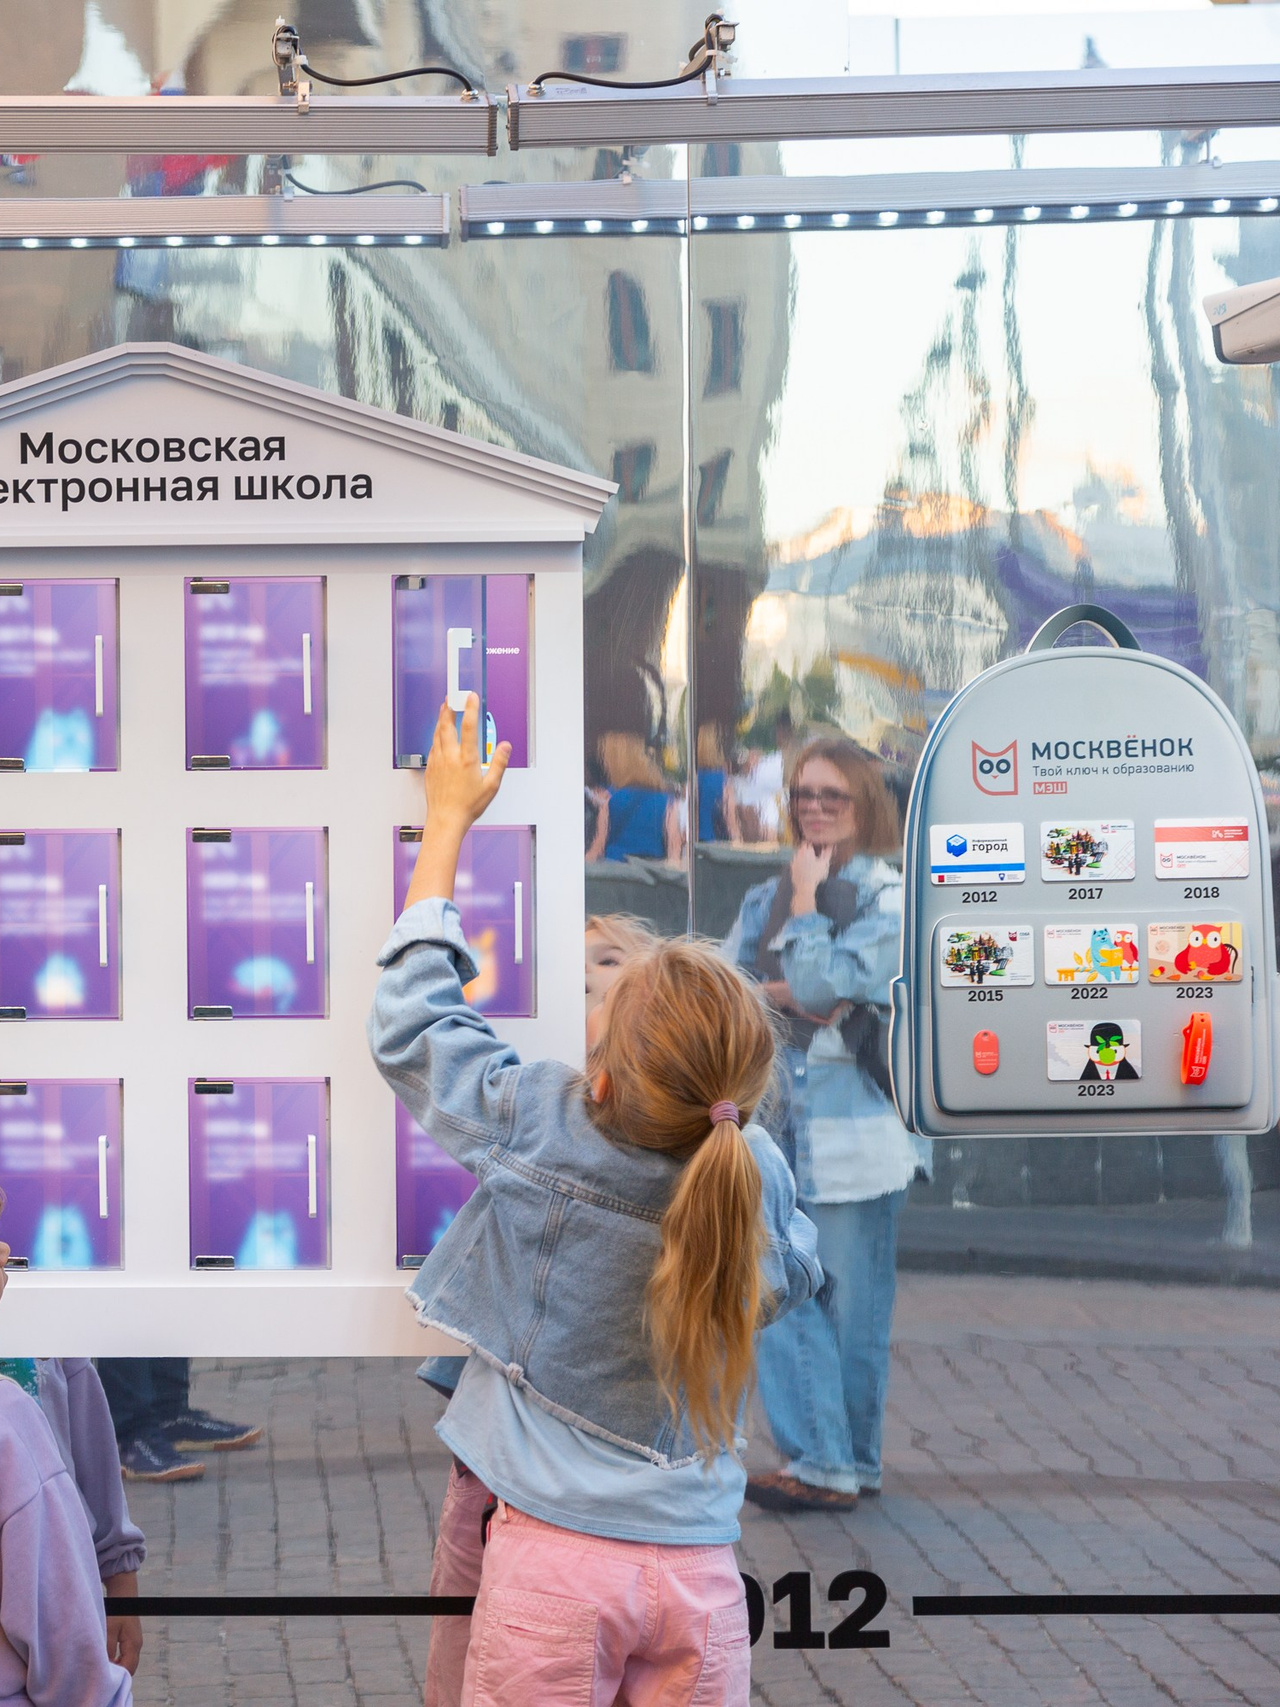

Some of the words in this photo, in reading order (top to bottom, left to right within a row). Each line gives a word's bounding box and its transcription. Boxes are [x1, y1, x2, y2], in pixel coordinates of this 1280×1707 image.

[19, 432, 286, 465] Московская
[234, 473, 373, 500] школа
[1032, 734, 1194, 760] МОСКВЁНОК
[1033, 765, 1062, 777] Твой
[1066, 766, 1098, 776] ключ
[1102, 766, 1109, 775] к
[1112, 763, 1194, 776] образованию
[1035, 782, 1066, 794] МЭШ
[972, 843, 1008, 853] город
[962, 891, 998, 904] 2012
[1068, 888, 1103, 900] 2017
[1184, 886, 1220, 899] 2018
[968, 990, 1003, 1002] 2015
[1070, 987, 1108, 1000] 2022
[1176, 986, 1213, 999] 2023
[1077, 1084, 1115, 1097] 2023
